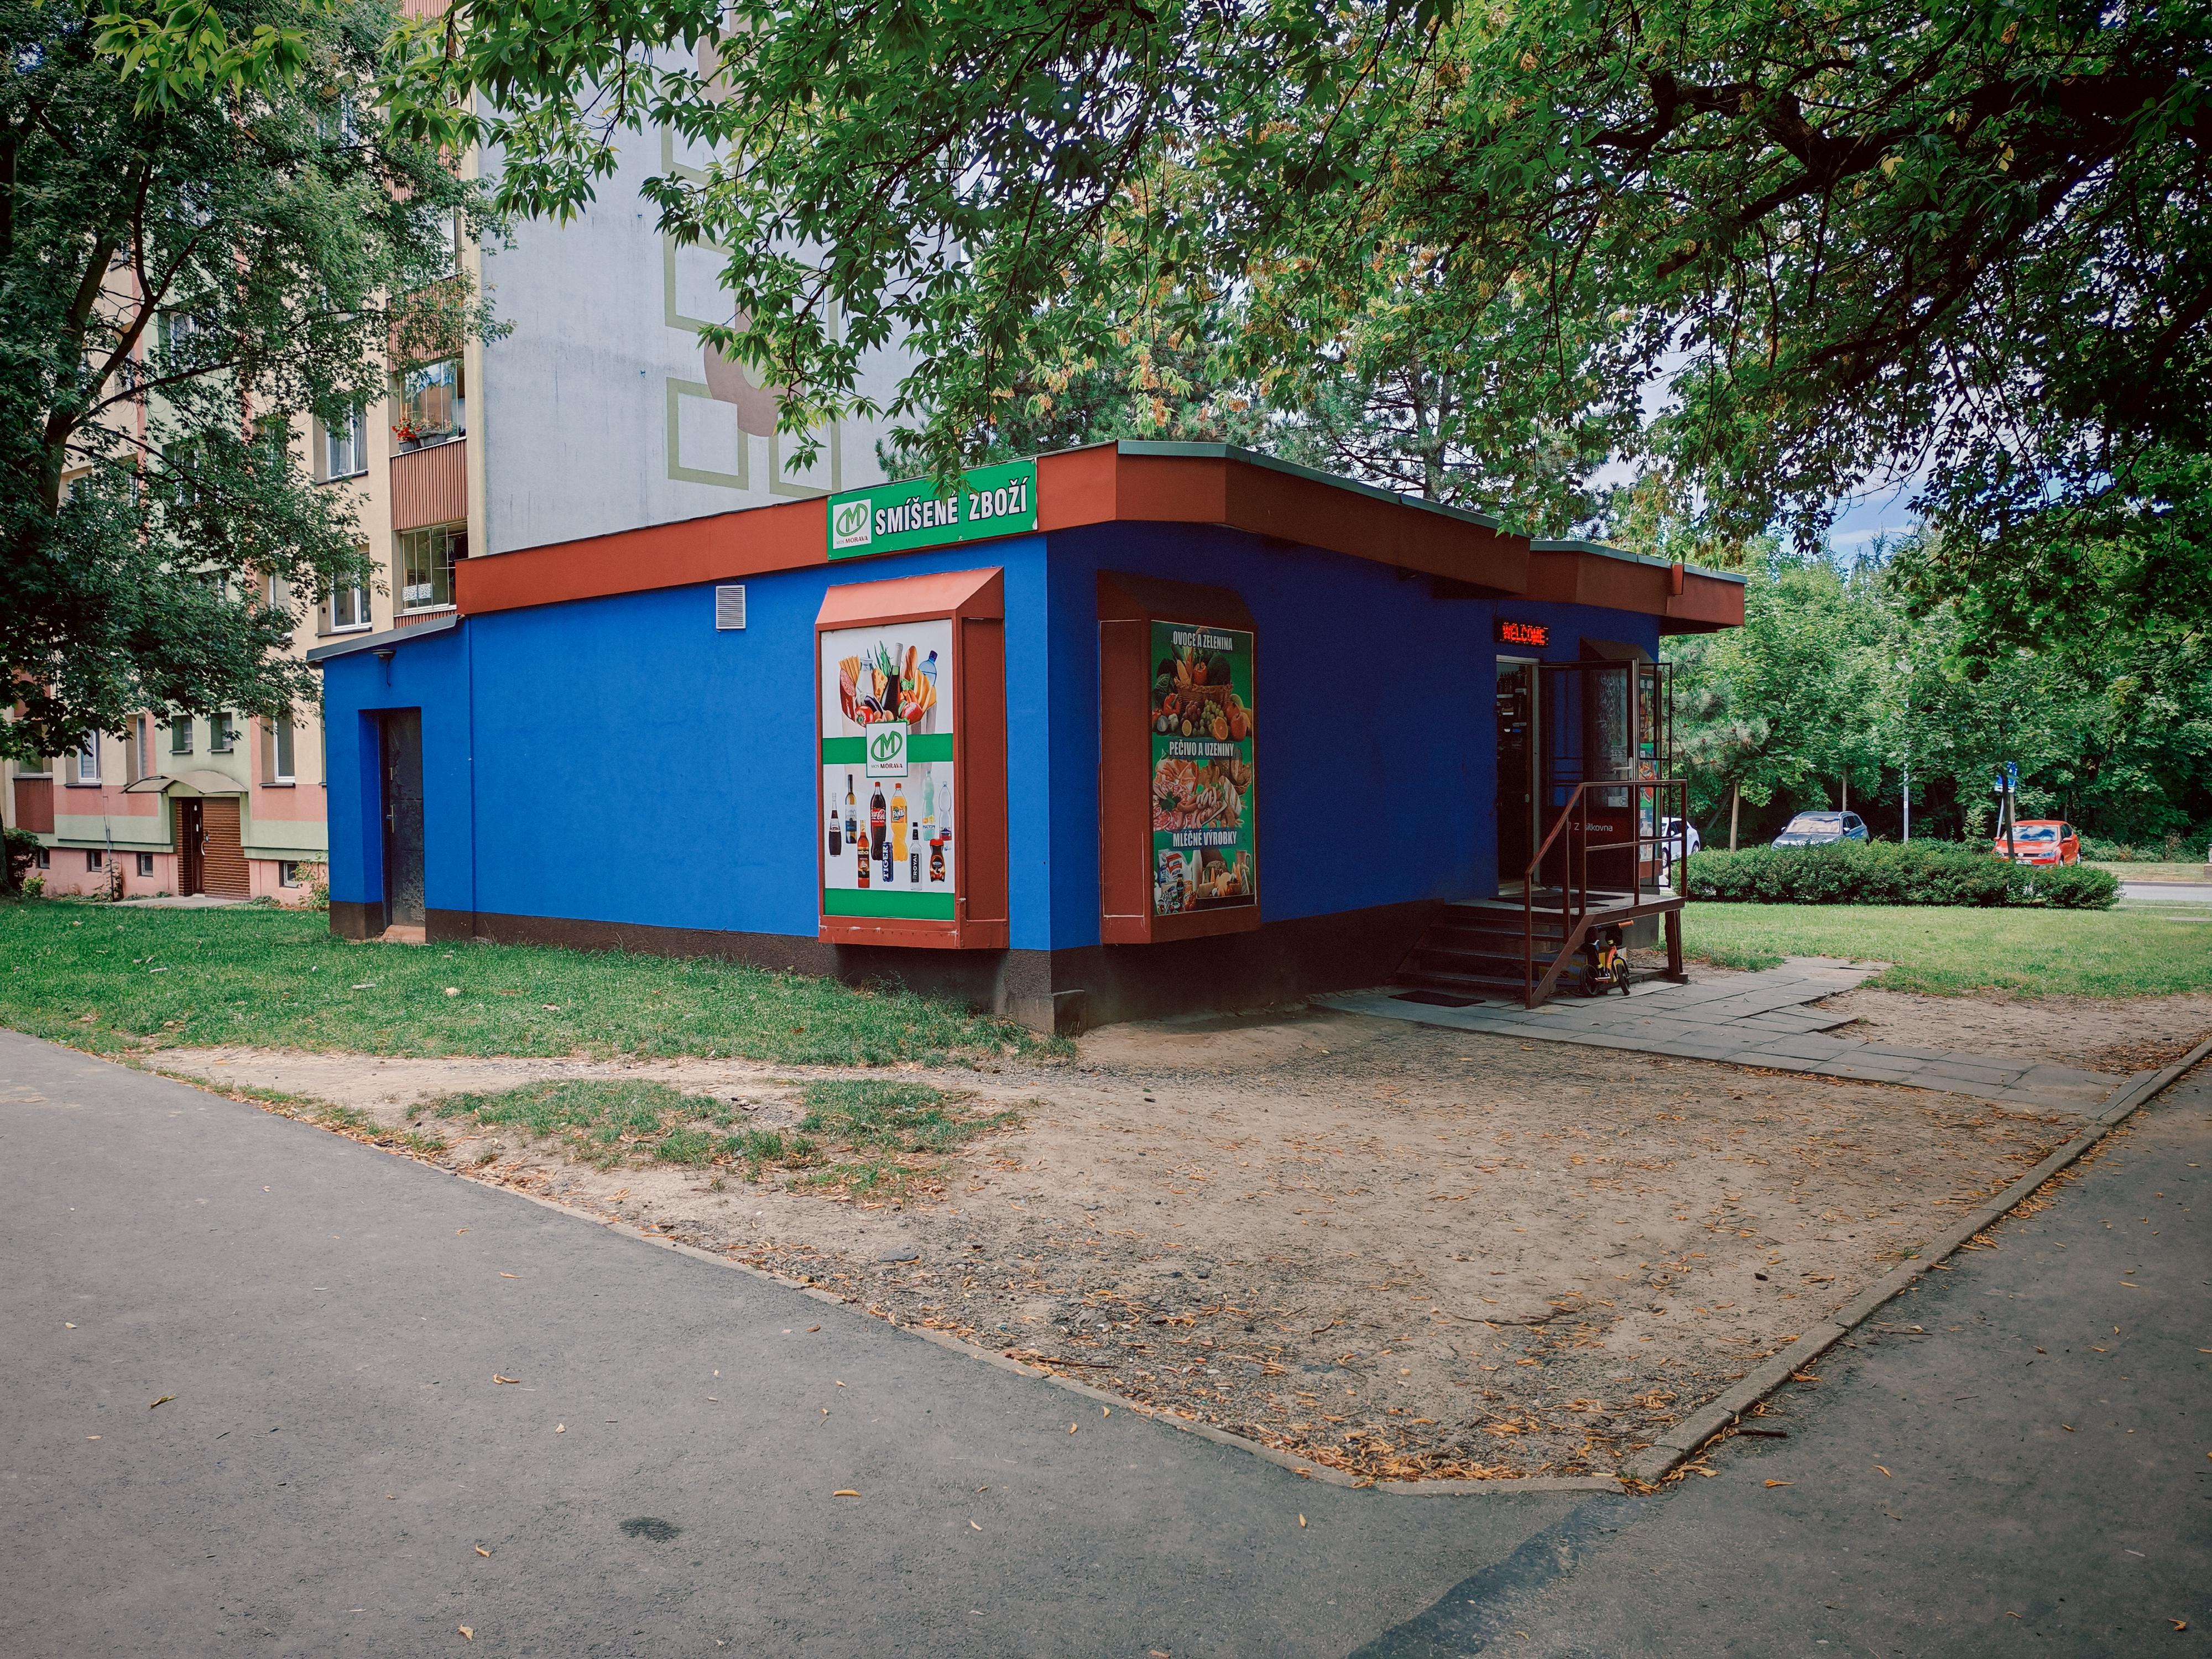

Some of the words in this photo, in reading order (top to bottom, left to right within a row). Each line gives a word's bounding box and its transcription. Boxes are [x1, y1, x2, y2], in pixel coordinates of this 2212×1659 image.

[875, 490, 958, 535] SMÍŠENÉ
[969, 476, 1030, 521] ZBOŽÍ
[1173, 631, 1196, 647] OVOCE
[1197, 634, 1202, 648] A
[1203, 634, 1233, 651] ZELENINA
[1503, 625, 1545, 644] WELCOME
[1169, 739, 1196, 756] PEČIVO
[1198, 742, 1203, 756] A
[1205, 743, 1234, 757] UZENINY
[1574, 822, 1613, 831] Zsilkovna
[1173, 830, 1202, 847] MLÉČNÉ
[1203, 830, 1237, 846] VÝROBKY
